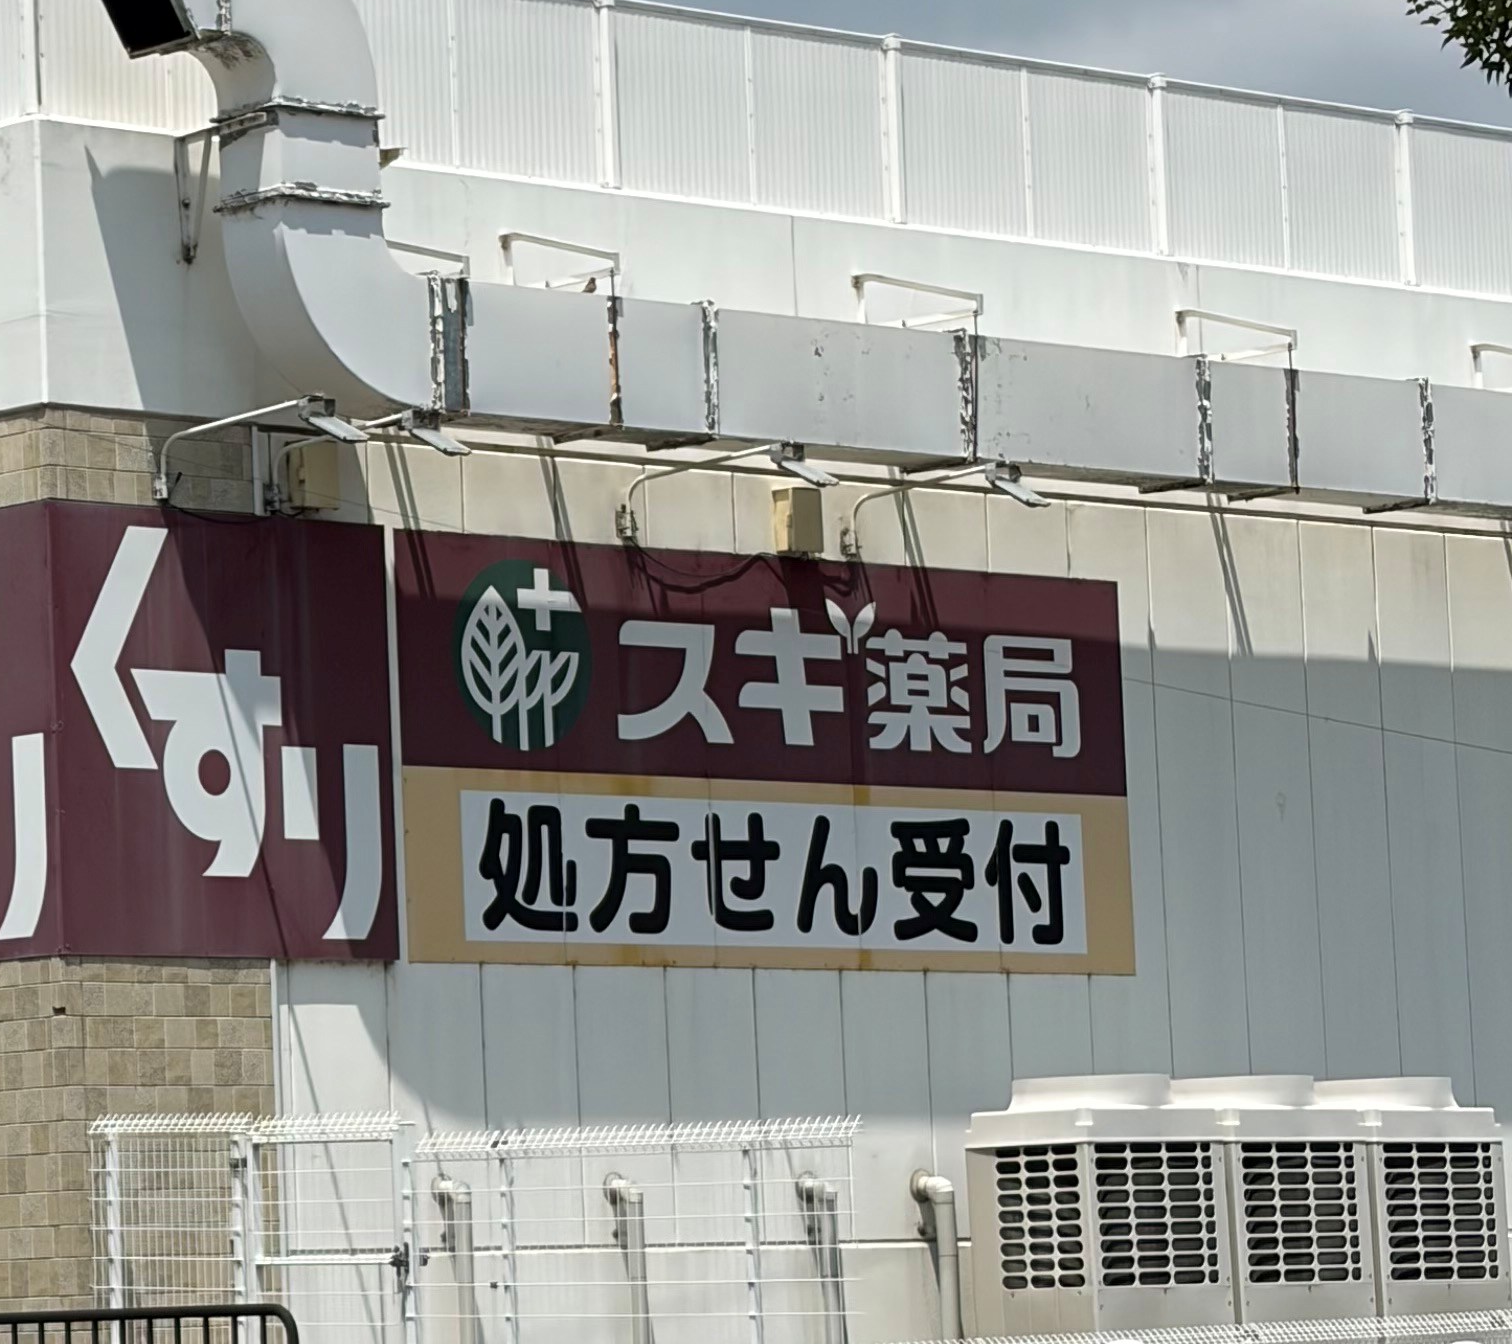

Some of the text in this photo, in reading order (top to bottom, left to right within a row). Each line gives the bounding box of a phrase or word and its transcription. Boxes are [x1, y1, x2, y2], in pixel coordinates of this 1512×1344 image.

[70, 525, 382, 939] くすり
[617, 598, 1081, 758] スギ薬局
[479, 797, 1071, 946] 処方せん受付
